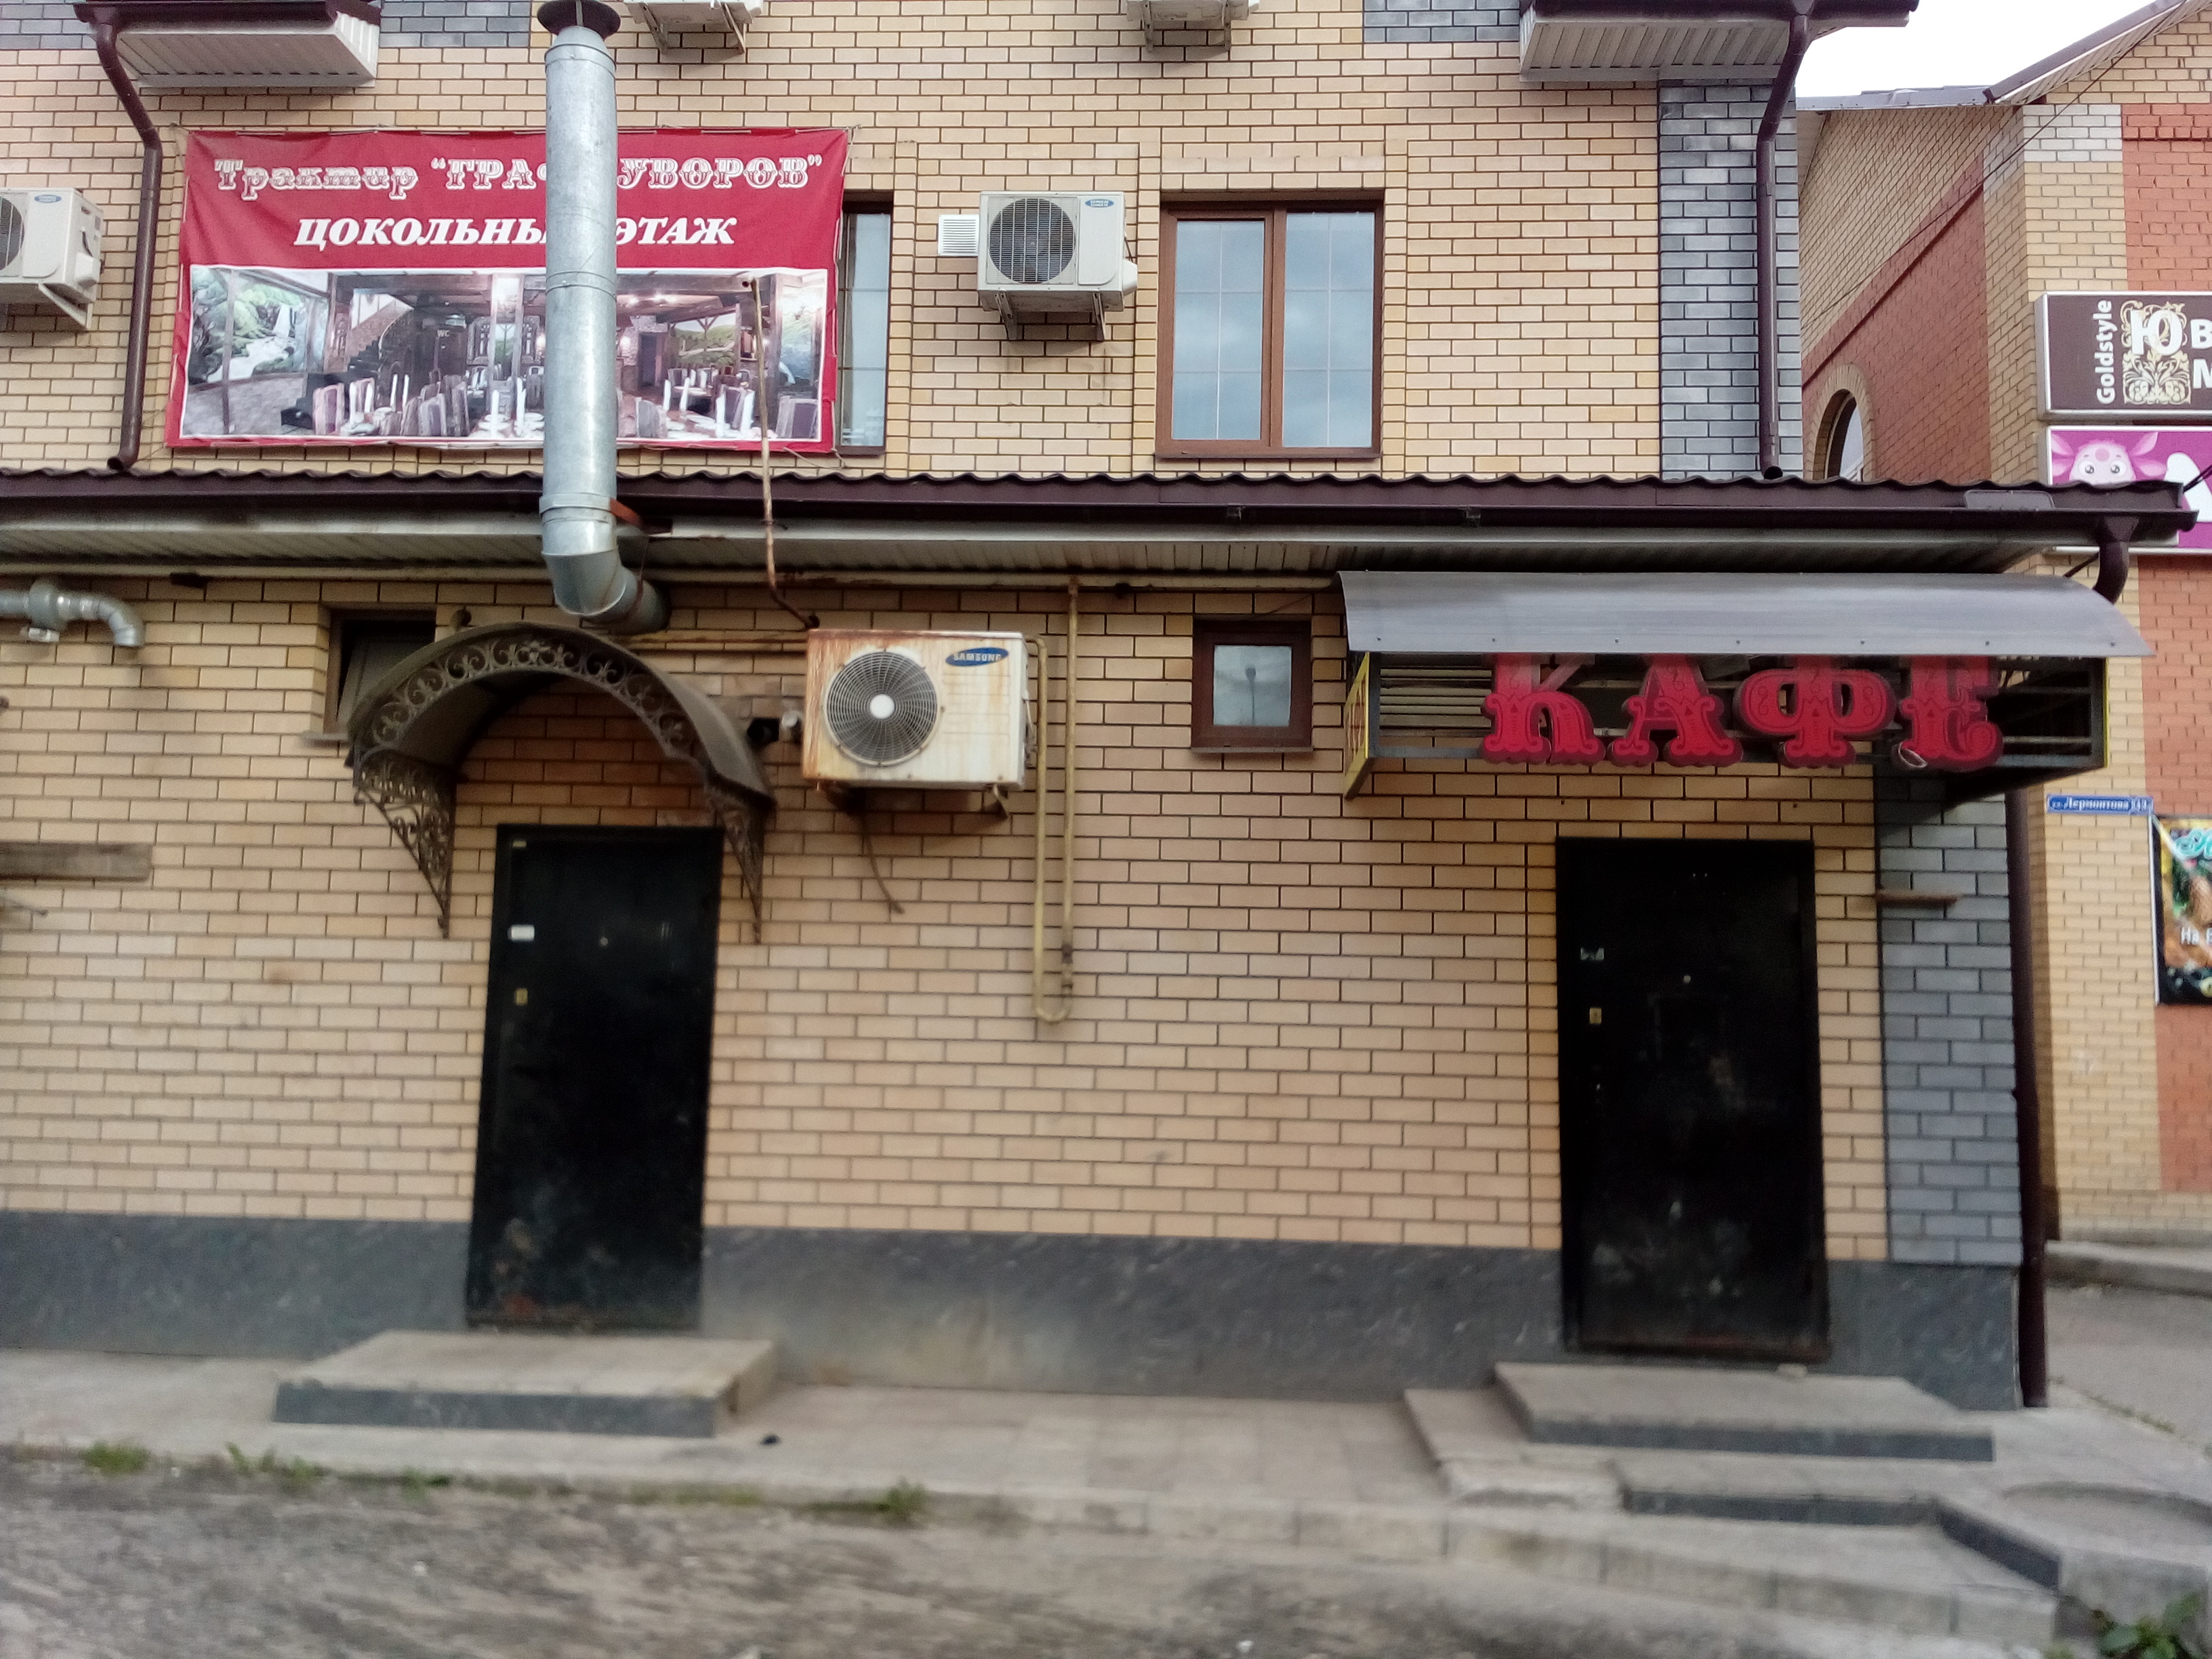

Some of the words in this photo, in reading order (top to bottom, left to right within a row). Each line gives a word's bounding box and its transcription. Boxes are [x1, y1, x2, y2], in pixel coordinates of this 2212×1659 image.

[214, 157, 419, 201] Трактир
[431, 157, 546, 190] “ГРА
[616, 154, 822, 190] УВОРОВ”
[293, 218, 546, 251] ЦОКОЛЬНЫ
[616, 217, 737, 245] ЭТАЖ
[437, 329, 450, 337] WC
[2093, 300, 2118, 405] Goldstyle
[953, 652, 1002, 662] SAMSUNG
